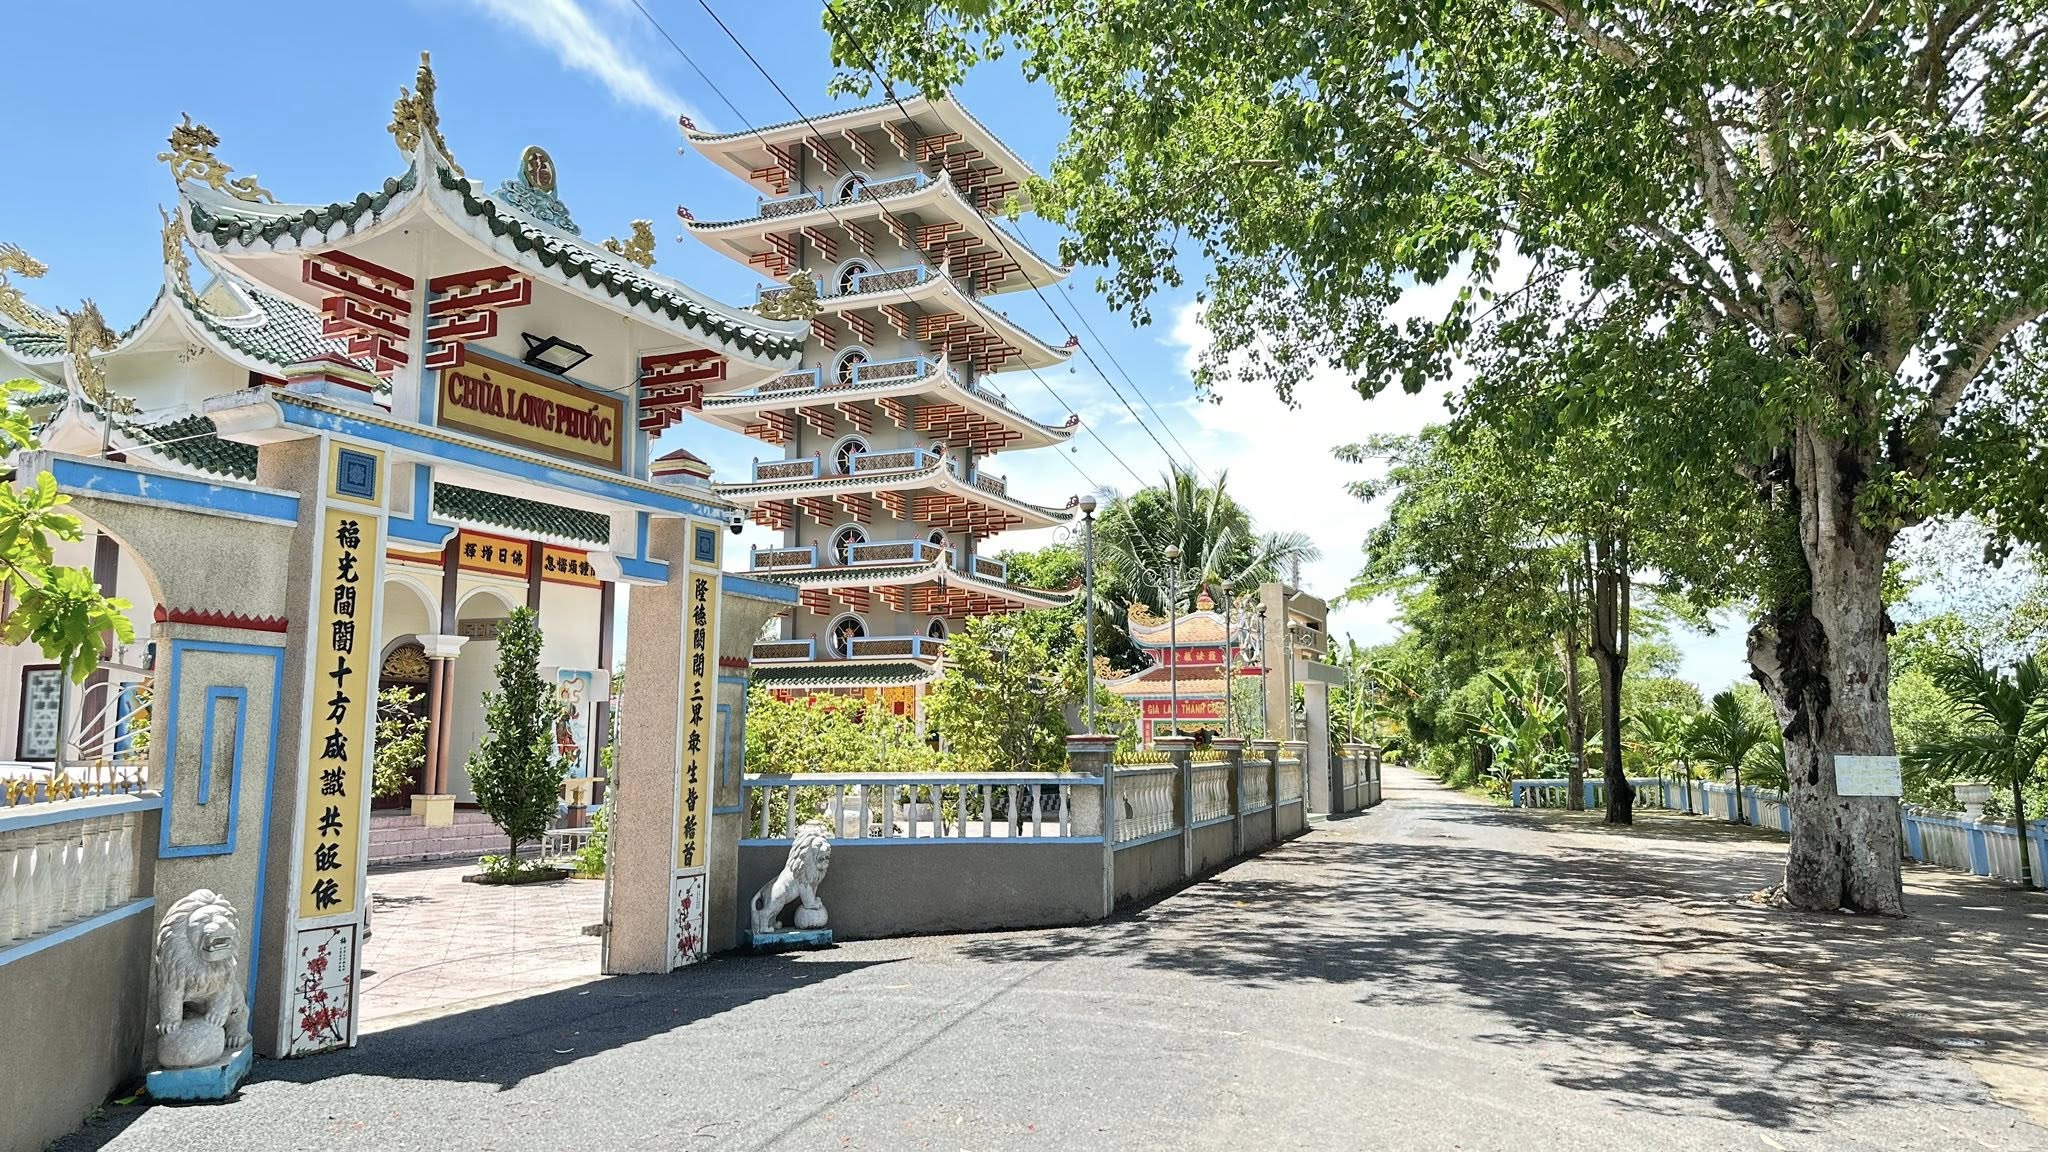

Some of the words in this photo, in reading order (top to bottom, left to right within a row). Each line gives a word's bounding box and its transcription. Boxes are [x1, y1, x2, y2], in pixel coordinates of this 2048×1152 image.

[448, 371, 505, 418] CHÙA
[506, 388, 555, 431] LONG
[555, 404, 612, 447] PHƯỚC
